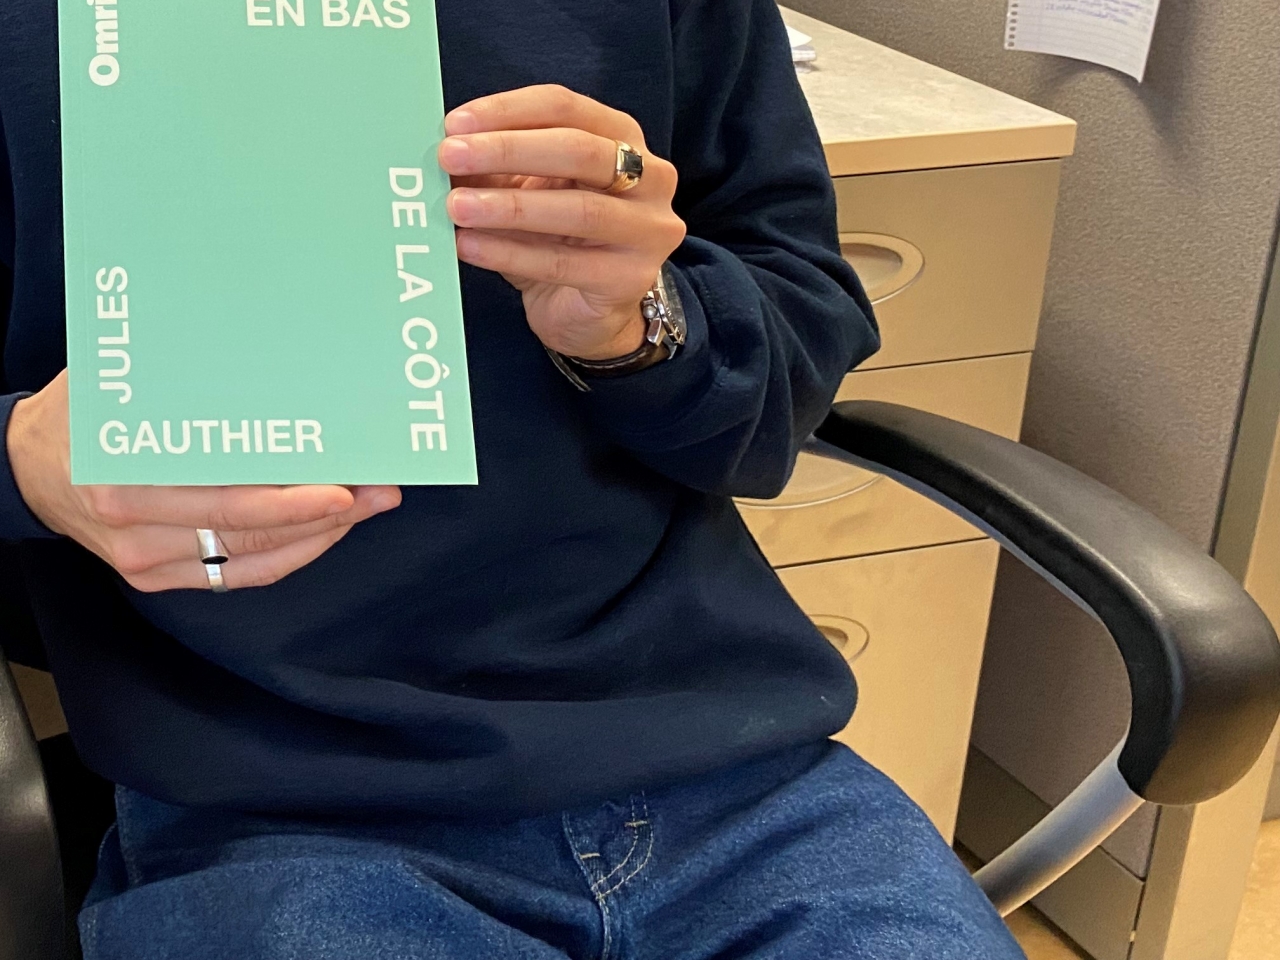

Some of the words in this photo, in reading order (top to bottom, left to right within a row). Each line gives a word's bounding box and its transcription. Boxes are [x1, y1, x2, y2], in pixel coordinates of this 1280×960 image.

[388, 166, 428, 229] DE
[394, 244, 434, 303] LA
[96, 265, 132, 405] JULES
[401, 316, 451, 453] CÔTE
[98, 419, 324, 456] GAUTHIER
